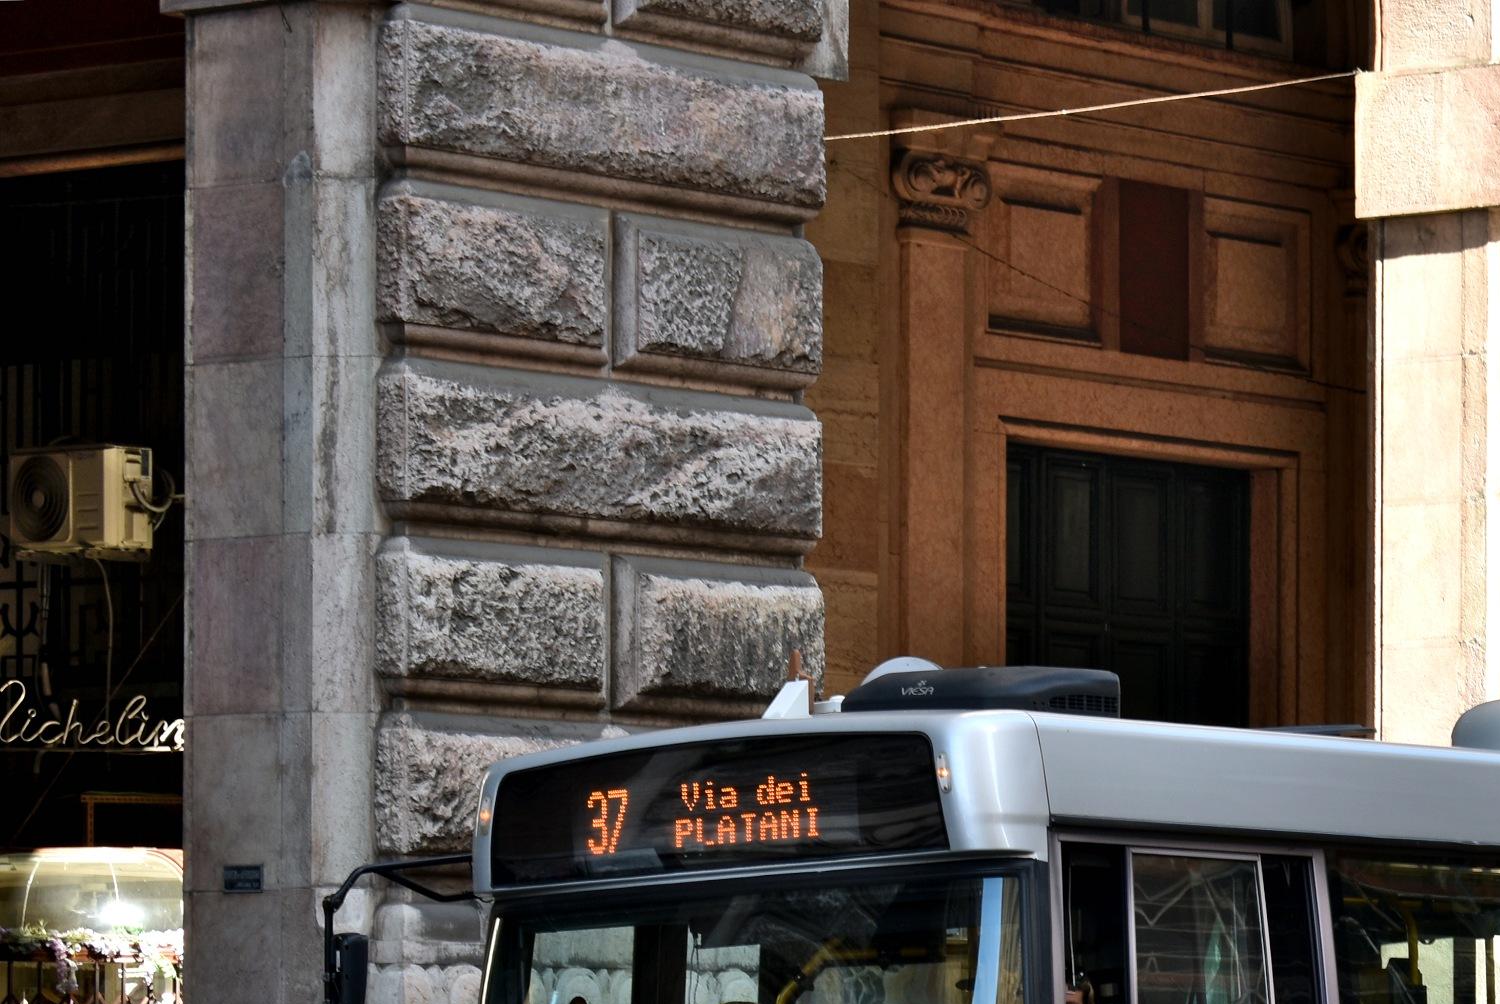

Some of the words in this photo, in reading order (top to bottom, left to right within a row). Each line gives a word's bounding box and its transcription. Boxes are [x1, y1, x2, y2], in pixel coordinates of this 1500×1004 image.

[681, 781, 737, 811] Via
[757, 772, 811, 806] dei
[587, 789, 628, 855] 37
[675, 807, 818, 848] PLATANI
